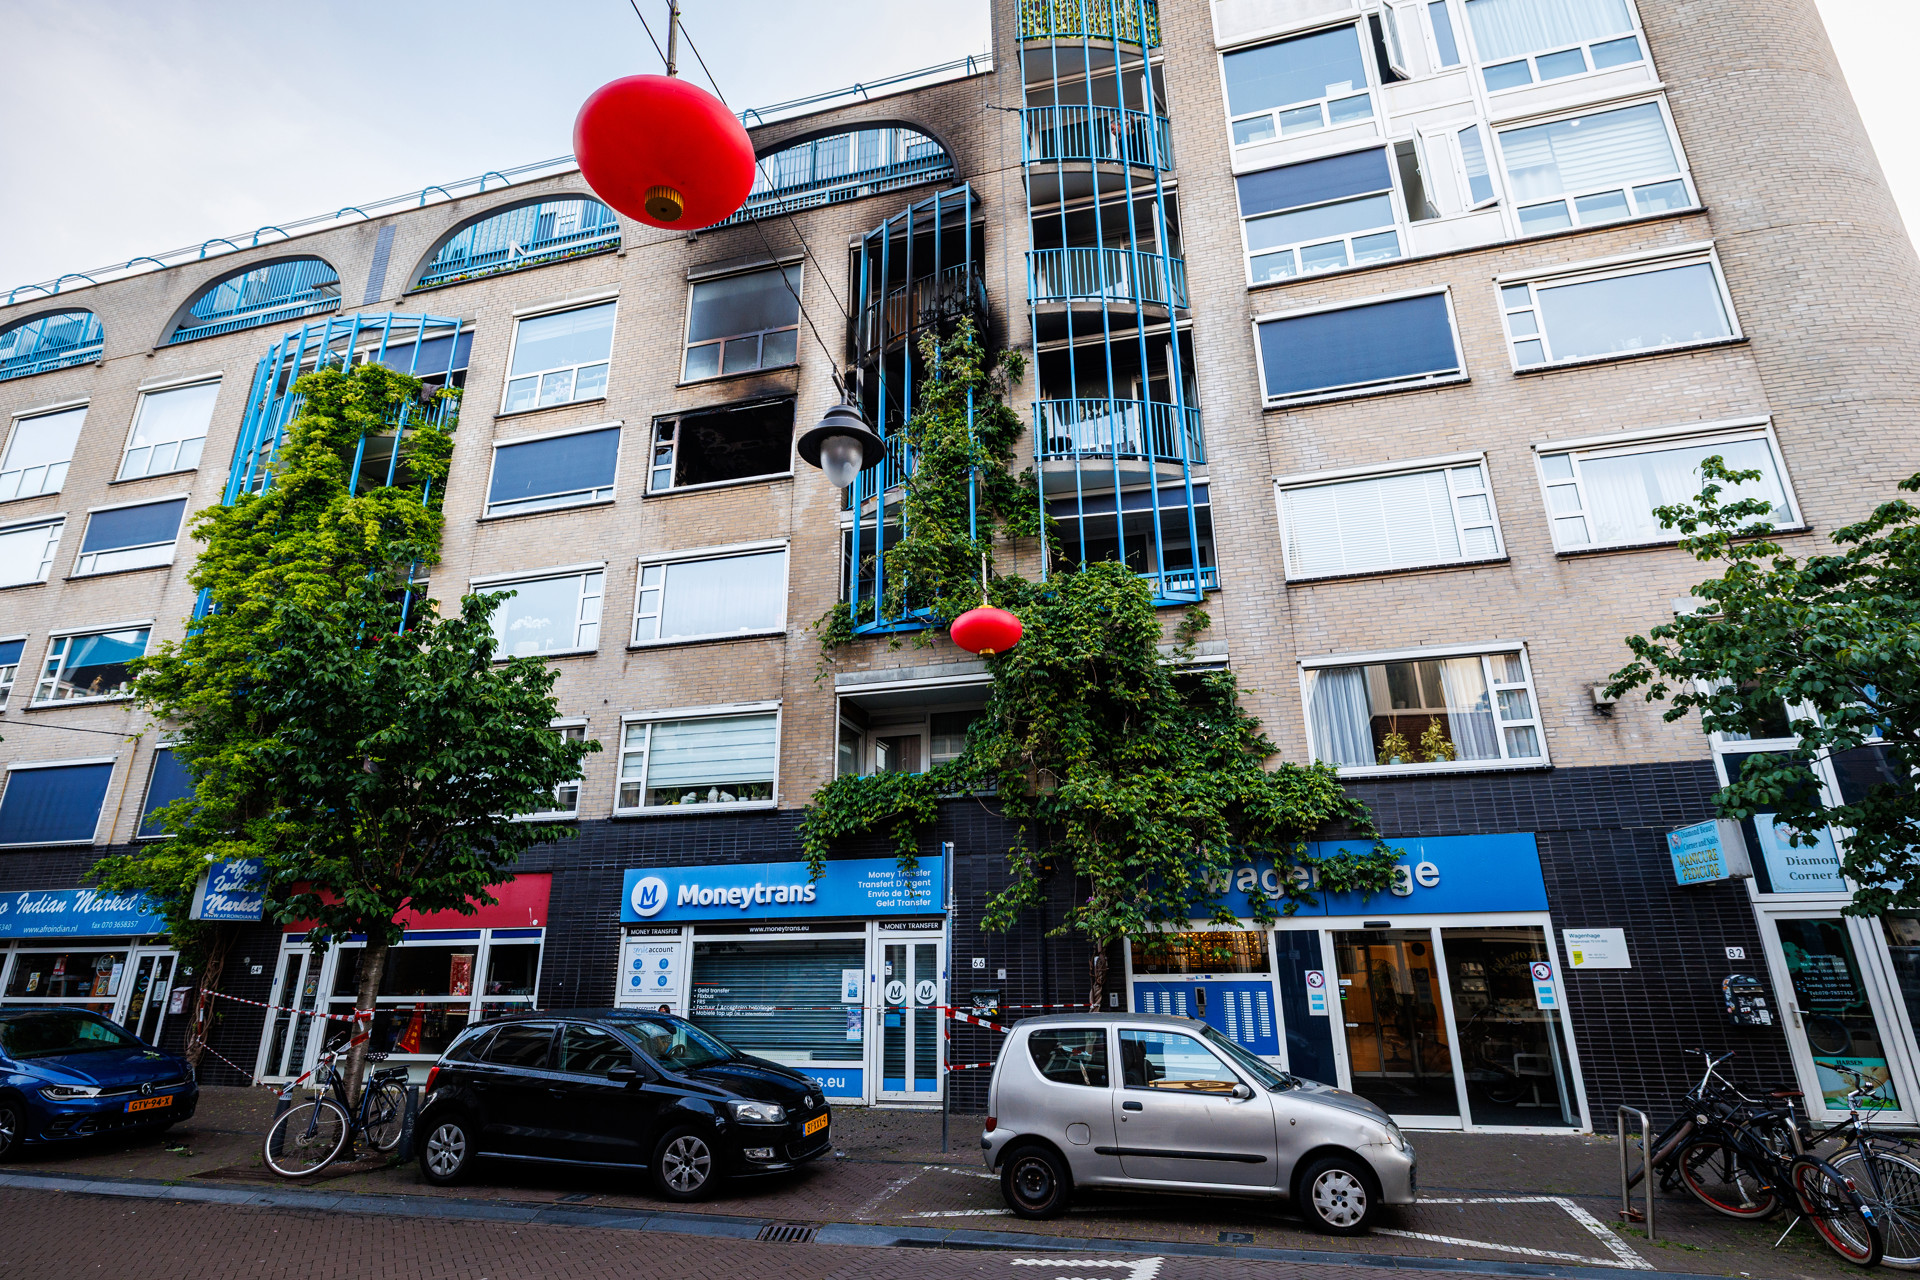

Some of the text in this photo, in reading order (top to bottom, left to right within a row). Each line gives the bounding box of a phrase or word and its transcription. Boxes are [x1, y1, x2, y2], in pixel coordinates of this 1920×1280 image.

[1676, 848, 1719, 868] MANICURE
[222, 858, 258, 879] Afro
[1681, 863, 1721, 880] PEDICURE
[868, 871, 895, 879] Money
[1201, 861, 1441, 900] wagege
[1789, 872, 1833, 880] Corner
[213, 875, 261, 892] Indi
[677, 882, 817, 909] Moneytrans
[891, 889, 902, 897] de
[16, 892, 67, 915] Indian
[74, 889, 138, 914] Market
[205, 893, 262, 912] Market
[876, 898, 932, 907] Geld Transfer
[23, 924, 78, 934] www.afroindian.nl
[91, 921, 100, 929] fax
[101, 921, 113, 929] 070
[749, 925, 810, 933] www.moneytrans.eu
[1728, 948, 1743, 958] 82
[973, 959, 984, 967] 66
[890, 985, 901, 997] M
[920, 985, 932, 997] M
[131, 1096, 170, 1111] GTV-94-X
